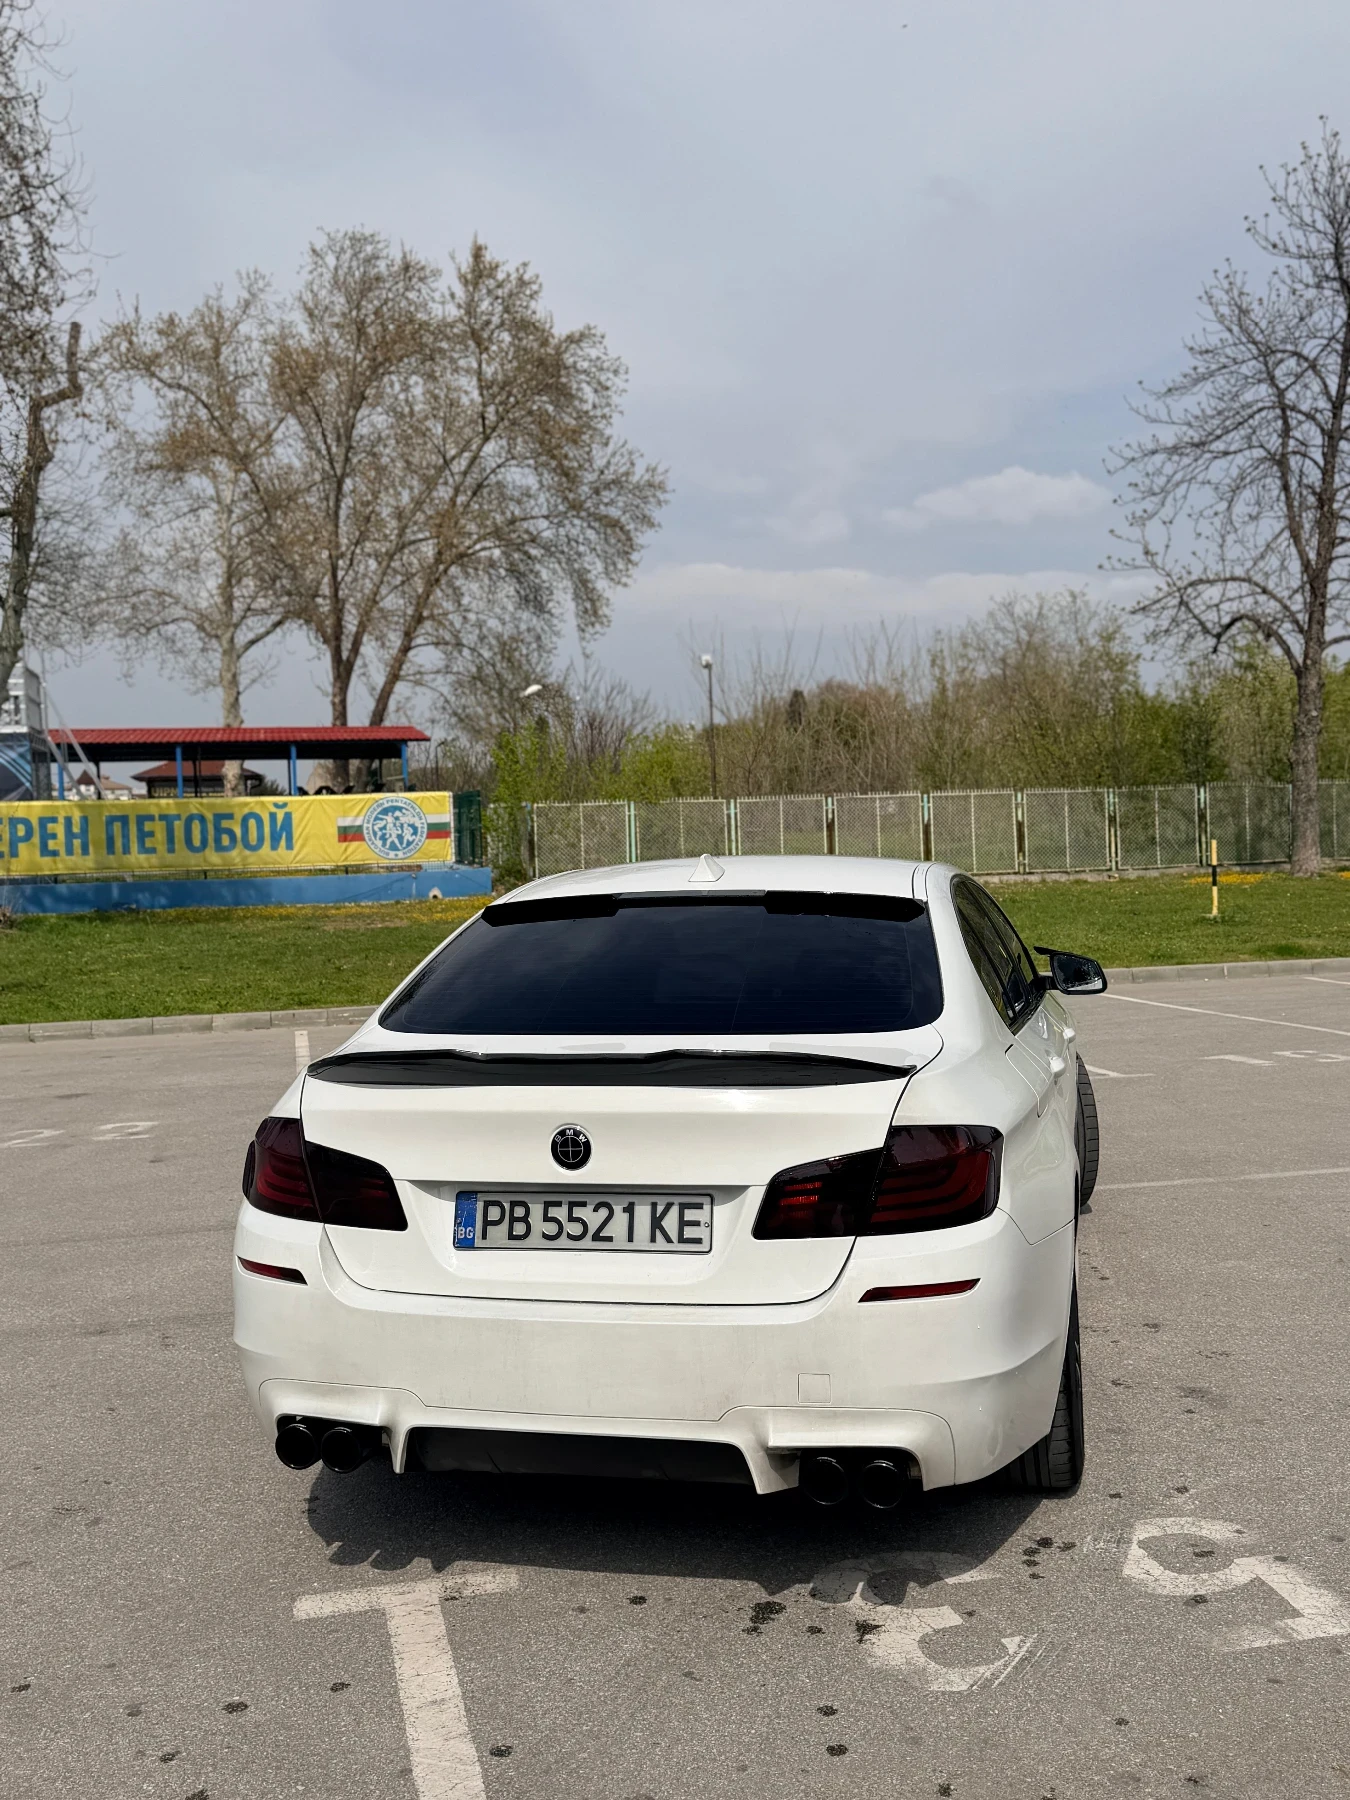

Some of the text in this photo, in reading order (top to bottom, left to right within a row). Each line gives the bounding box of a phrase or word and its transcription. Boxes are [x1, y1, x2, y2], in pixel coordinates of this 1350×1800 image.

[366, 802, 385, 824] MODERN
[0, 802, 294, 858] РЕН ПЕТОБОЙ
[554, 1129, 587, 1142] BMW
[458, 1226, 474, 1239] BG
